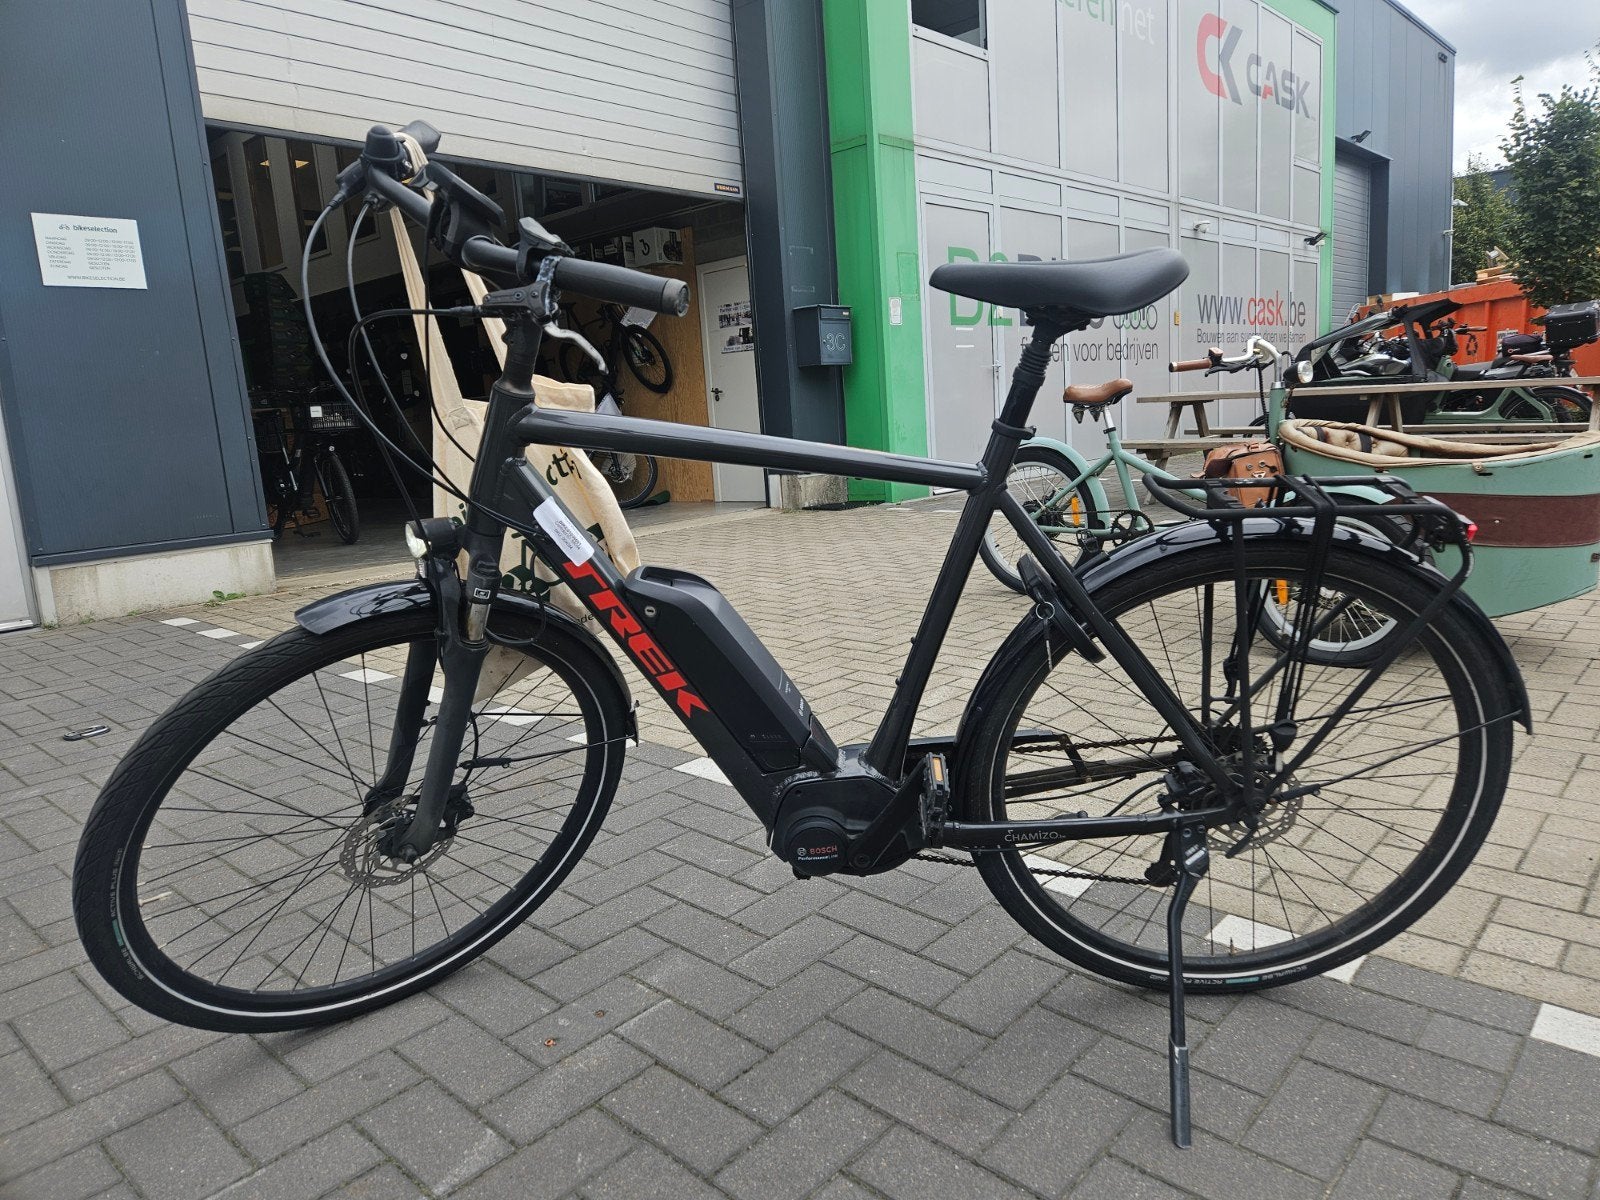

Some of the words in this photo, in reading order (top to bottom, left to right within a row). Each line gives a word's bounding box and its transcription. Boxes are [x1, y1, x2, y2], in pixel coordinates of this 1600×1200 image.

[1246, 53, 1311, 119] CASK
[73, 224, 118, 234] bikeselection
[1197, 290, 1306, 327] www.cask.be
[826, 332, 846, 351] 3C
[1073, 343, 1103, 361] voor
[1106, 337, 1159, 366] bedrijven
[562, 560, 711, 718] TREK
[810, 845, 838, 855] BOSCH
